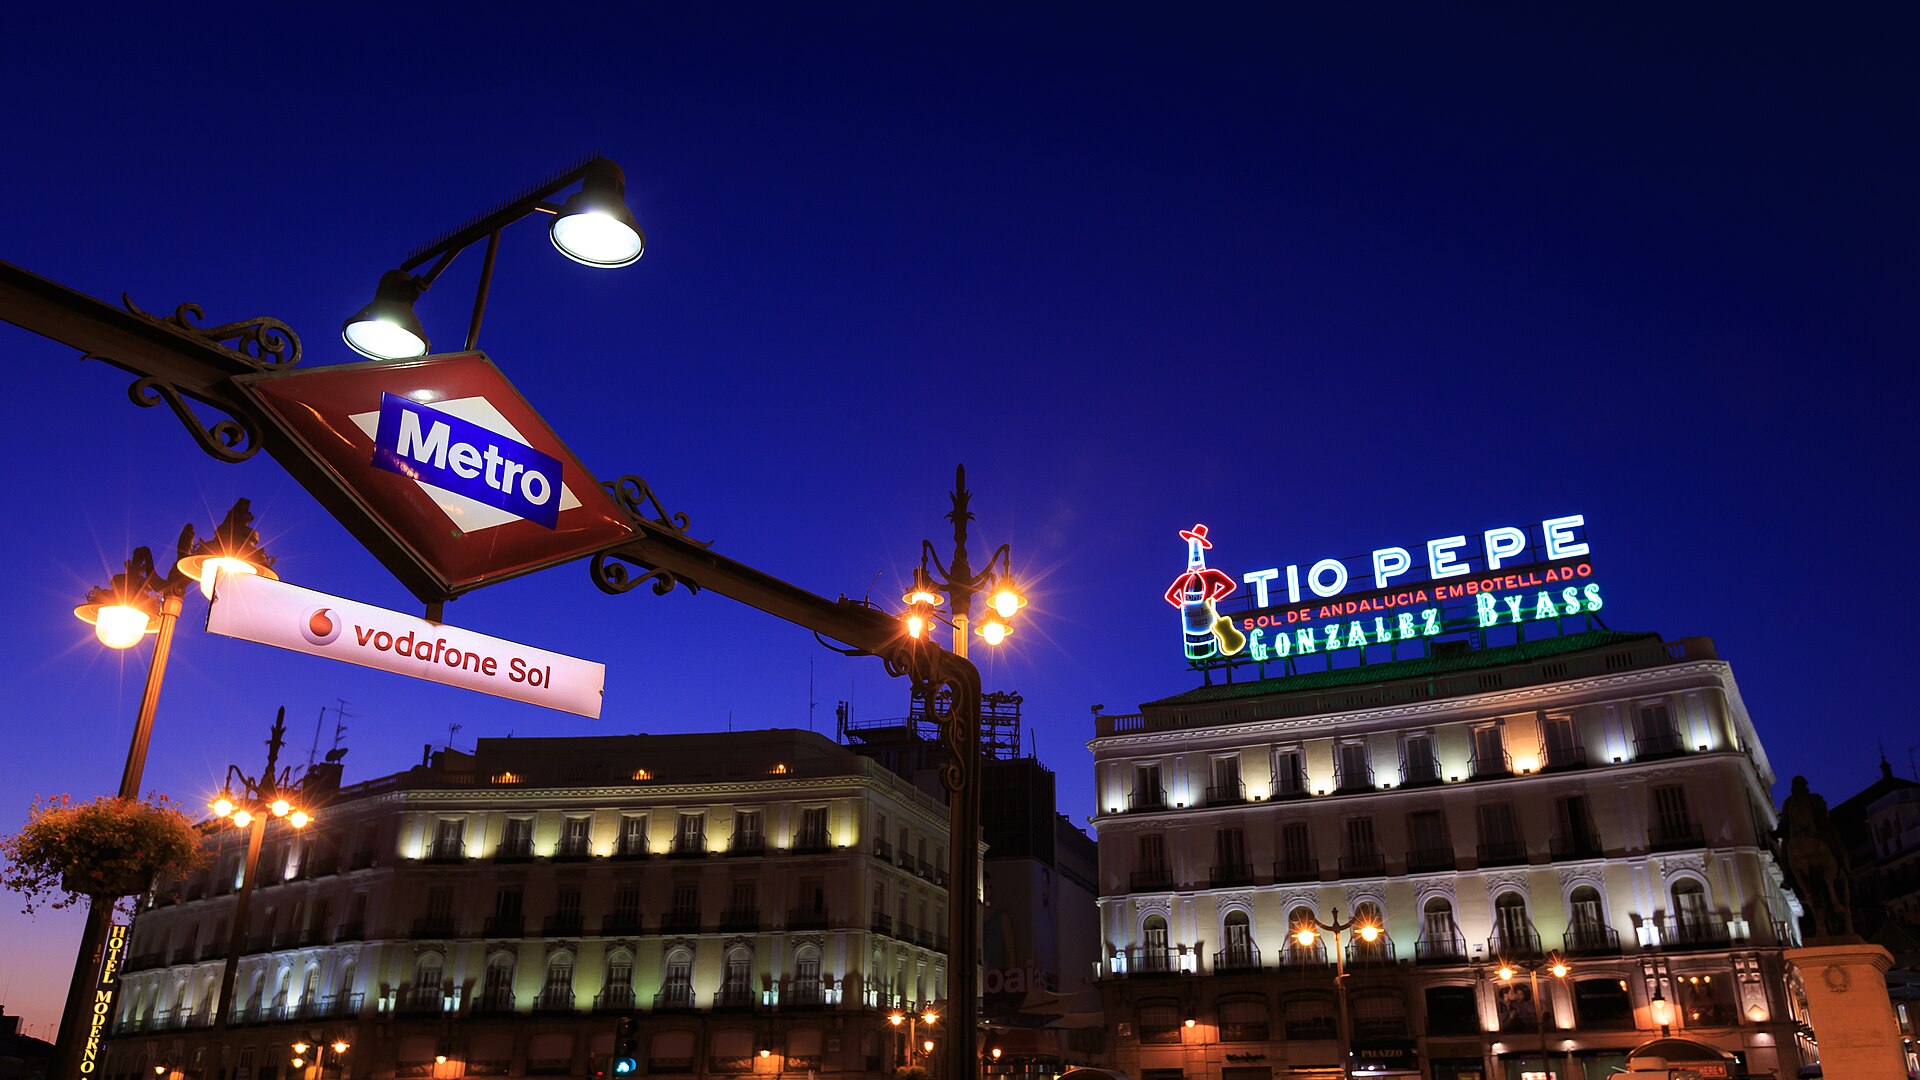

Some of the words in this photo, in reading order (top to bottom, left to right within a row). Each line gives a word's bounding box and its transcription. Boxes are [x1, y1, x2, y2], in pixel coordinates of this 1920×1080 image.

[396, 409, 551, 506] Metro
[1243, 558, 1348, 608] TIO
[1372, 514, 1590, 588] PEPE
[1243, 614, 1282, 630] SOL
[1287, 608, 1311, 622] DE
[1319, 590, 1427, 618] ANDALUCIA
[1435, 564, 1592, 599] EMBOTELLADO
[354, 624, 497, 677] vodafone
[508, 657, 551, 690] Sol
[1250, 608, 1440, 661] GONZALEZ
[1477, 583, 1603, 628] BYASS
[102, 925, 126, 984] HOTEL
[80, 990, 112, 1074] MODERNO
[1361, 1048, 1403, 1058] PALAZZO
